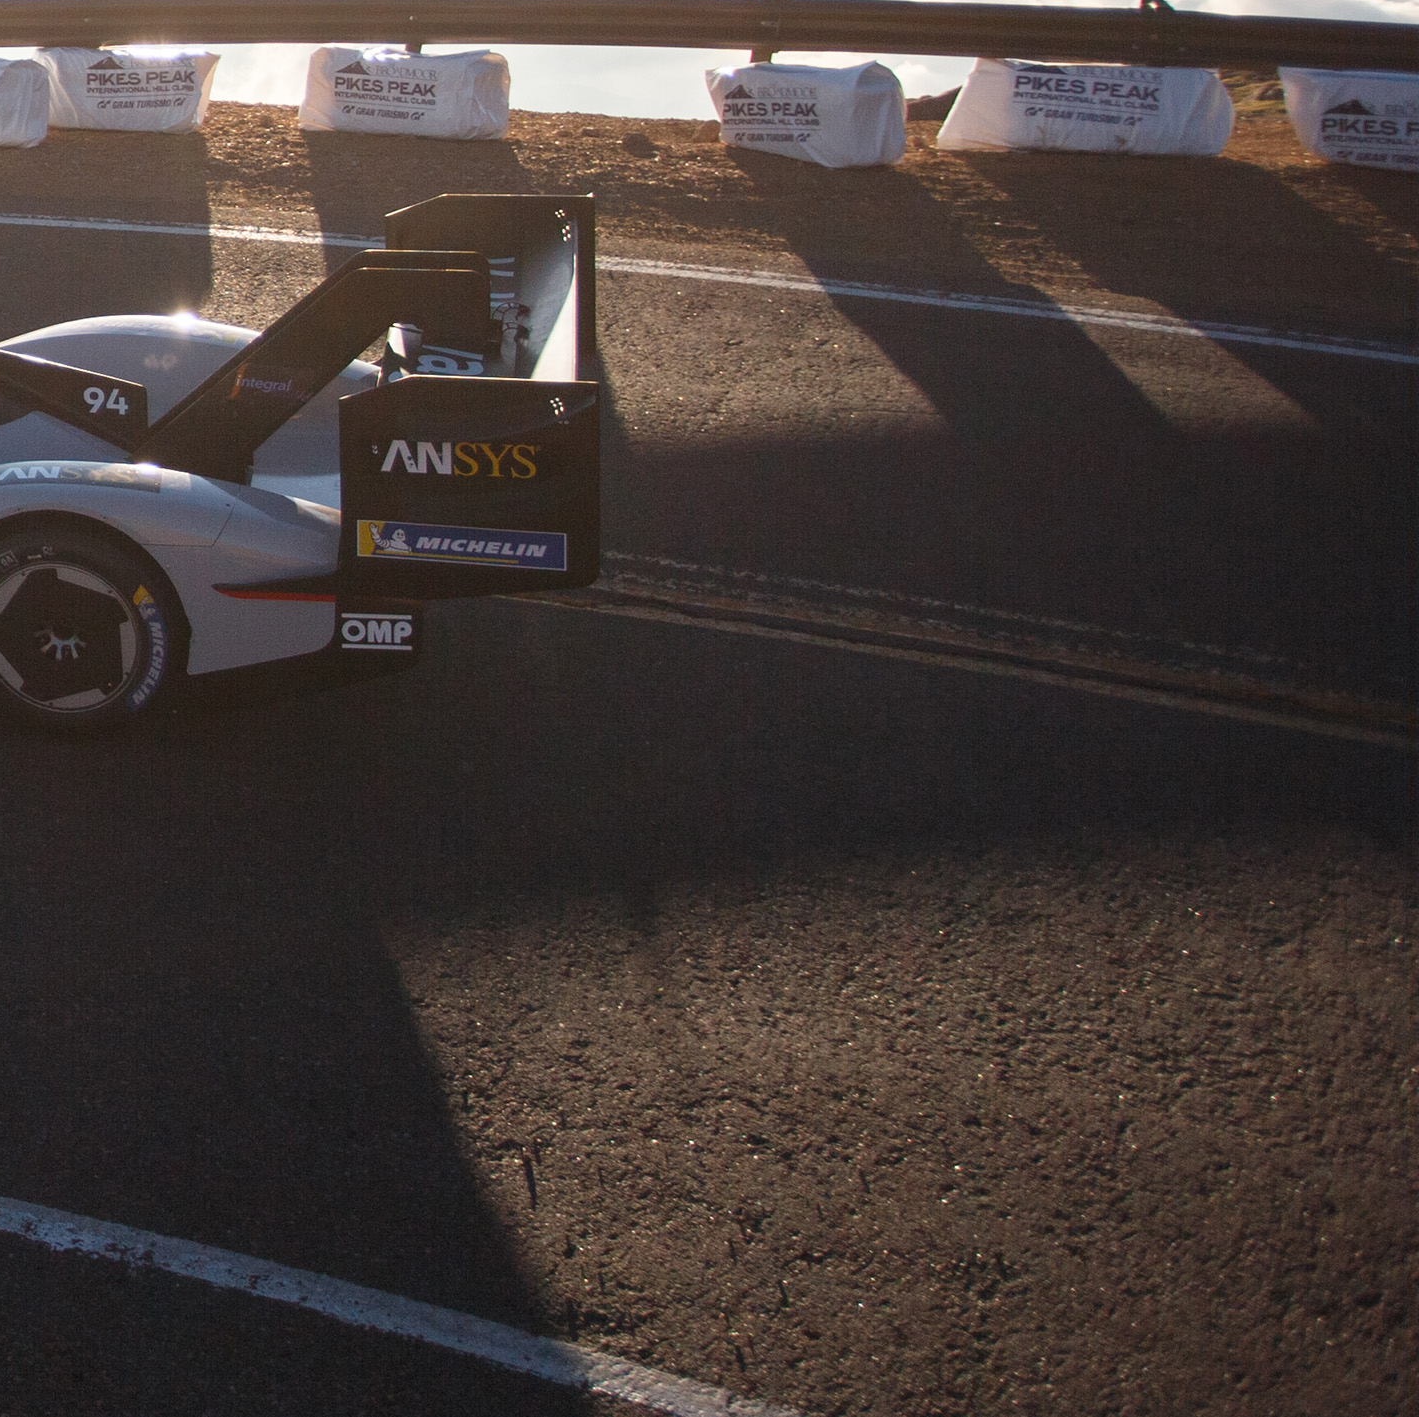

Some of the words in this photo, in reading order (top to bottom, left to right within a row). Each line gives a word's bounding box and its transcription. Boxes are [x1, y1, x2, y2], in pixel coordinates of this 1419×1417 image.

[86, 72, 141, 86] PIKES
[145, 70, 195, 84] PEAK
[334, 76, 383, 93] PIKES
[388, 81, 436, 97] PEAK
[86, 86, 150, 94] INTERNATIONAL
[170, 84, 195, 92] CLIMB
[1014, 75, 1086, 94] PIKES
[1091, 81, 1159, 103] PEAK
[112, 101, 134, 109] GRAN
[136, 99, 171, 108] TURISMO
[334, 91, 390, 101] INTERNATIONAL
[410, 97, 436, 106] CLIMB
[355, 107, 375, 116] GRAN
[377, 108, 409, 119] TURISMO
[723, 102, 768, 117] PIKES
[771, 102, 818, 117] PEAK
[1321, 118, 1398, 136] PIKES
[236, 375, 292, 393] integral
[83, 386, 129, 415] 94
[380, 439, 537, 479] ANSYS
[415, 536, 547, 557] MICHELIN
[341, 619, 412, 644] OMP
[132, 621, 164, 705] MICHELIN
